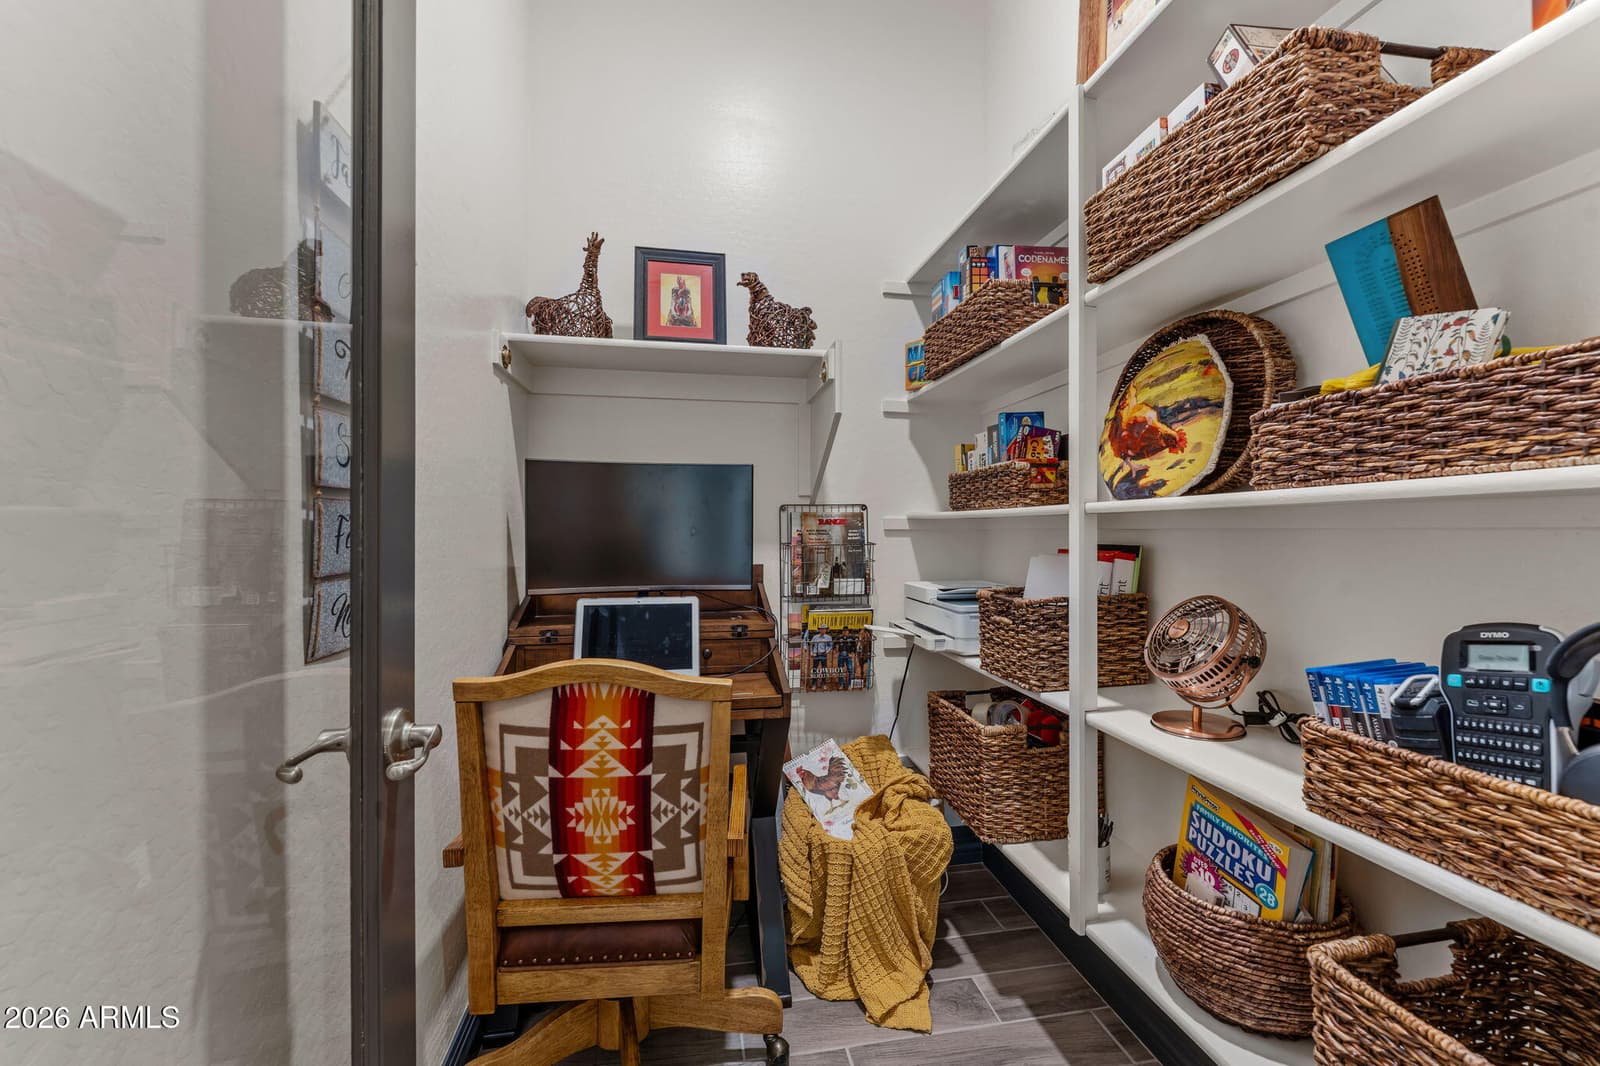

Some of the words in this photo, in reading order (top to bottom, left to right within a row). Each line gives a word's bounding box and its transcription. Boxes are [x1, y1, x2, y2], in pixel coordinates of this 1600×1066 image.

[1018, 254, 1069, 265] CODENAMES
[1350, 690, 1358, 709] PS4
[1365, 691, 1374, 710] PS4
[1195, 803, 1220, 823] FAMILY
[1221, 820, 1270, 864] FAVORITES
[1191, 810, 1272, 882] SUDOKU
[1188, 825, 1255, 889] PUZZLES
[1259, 887, 1276, 908] 28
